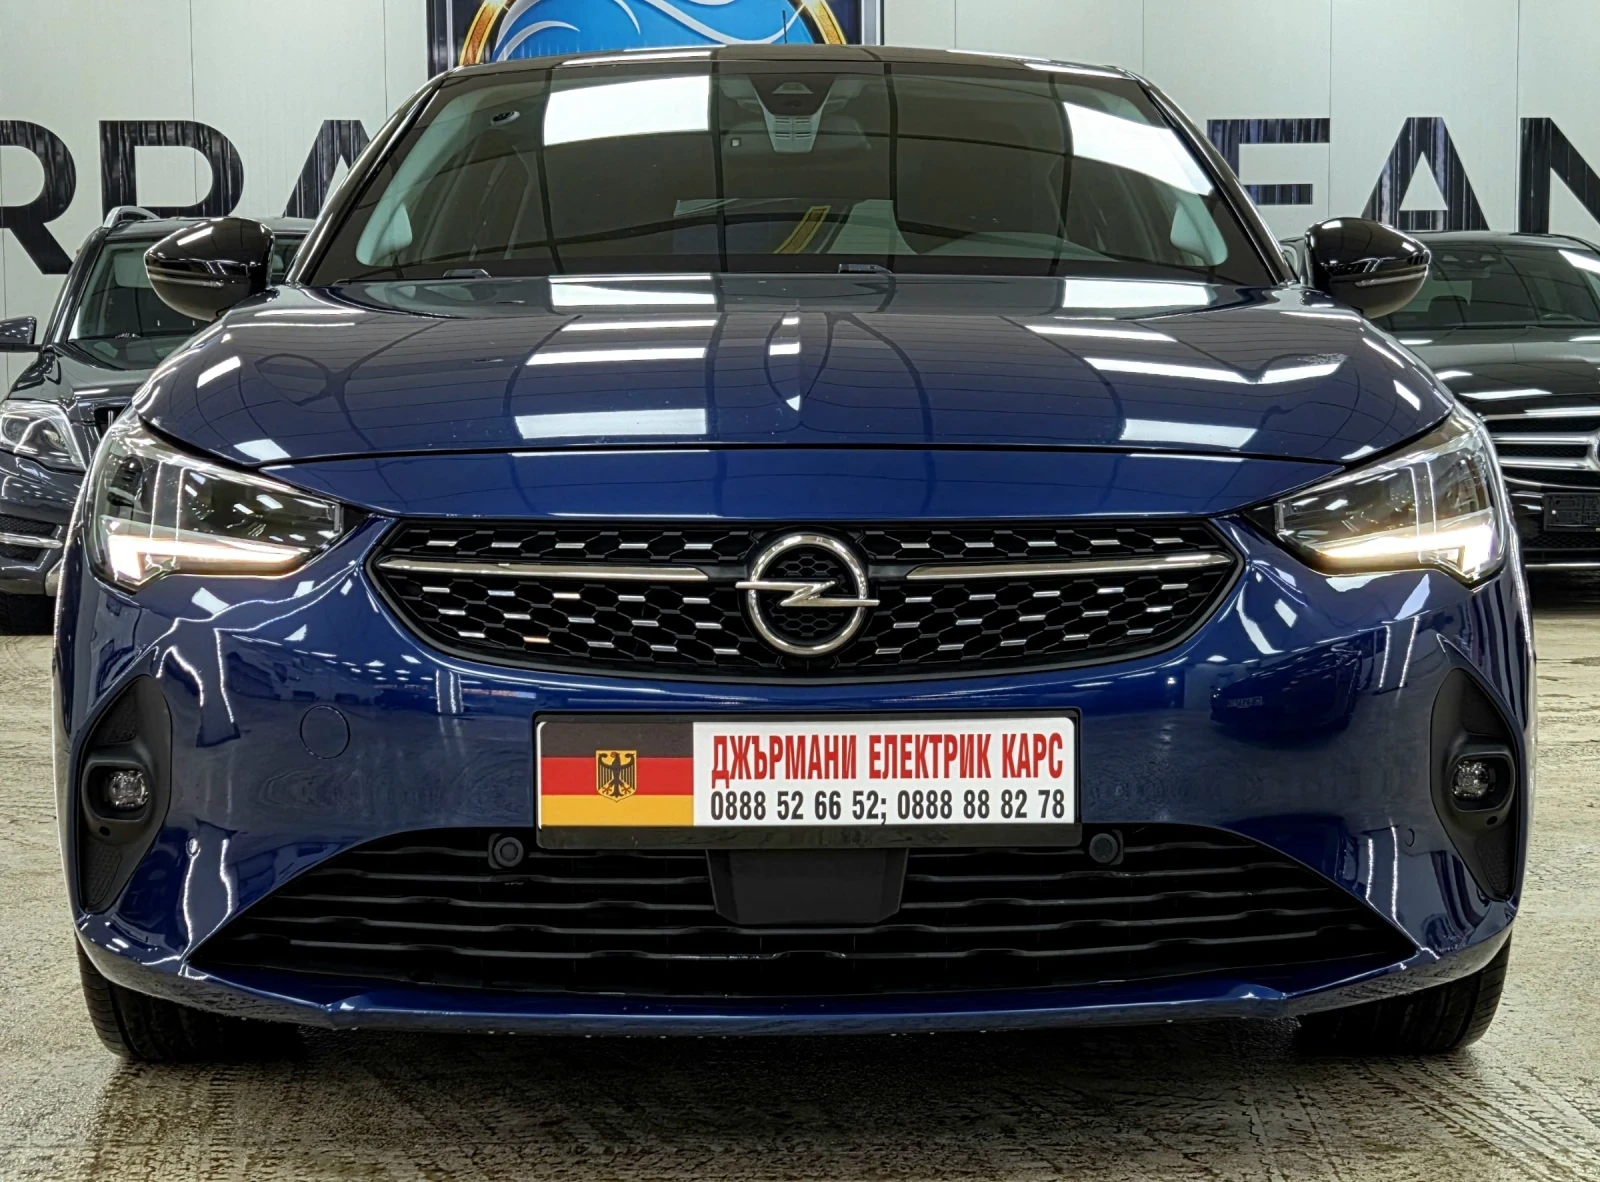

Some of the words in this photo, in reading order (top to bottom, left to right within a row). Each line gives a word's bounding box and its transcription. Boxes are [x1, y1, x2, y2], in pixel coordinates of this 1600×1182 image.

[711, 734, 857, 789] ДЖЪРМАНИ
[868, 733, 991, 779] ЕЛЕКТРИК
[1001, 732, 1063, 778] КАРС
[711, 790, 766, 821] 0888
[777, 790, 803, 821] 52
[814, 790, 841, 821] 66
[852, 790, 887, 825] 52;
[897, 789, 952, 819] 0888
[963, 789, 990, 819] 88
[1001, 789, 1027, 819] 82
[1038, 789, 1065, 819] 78
